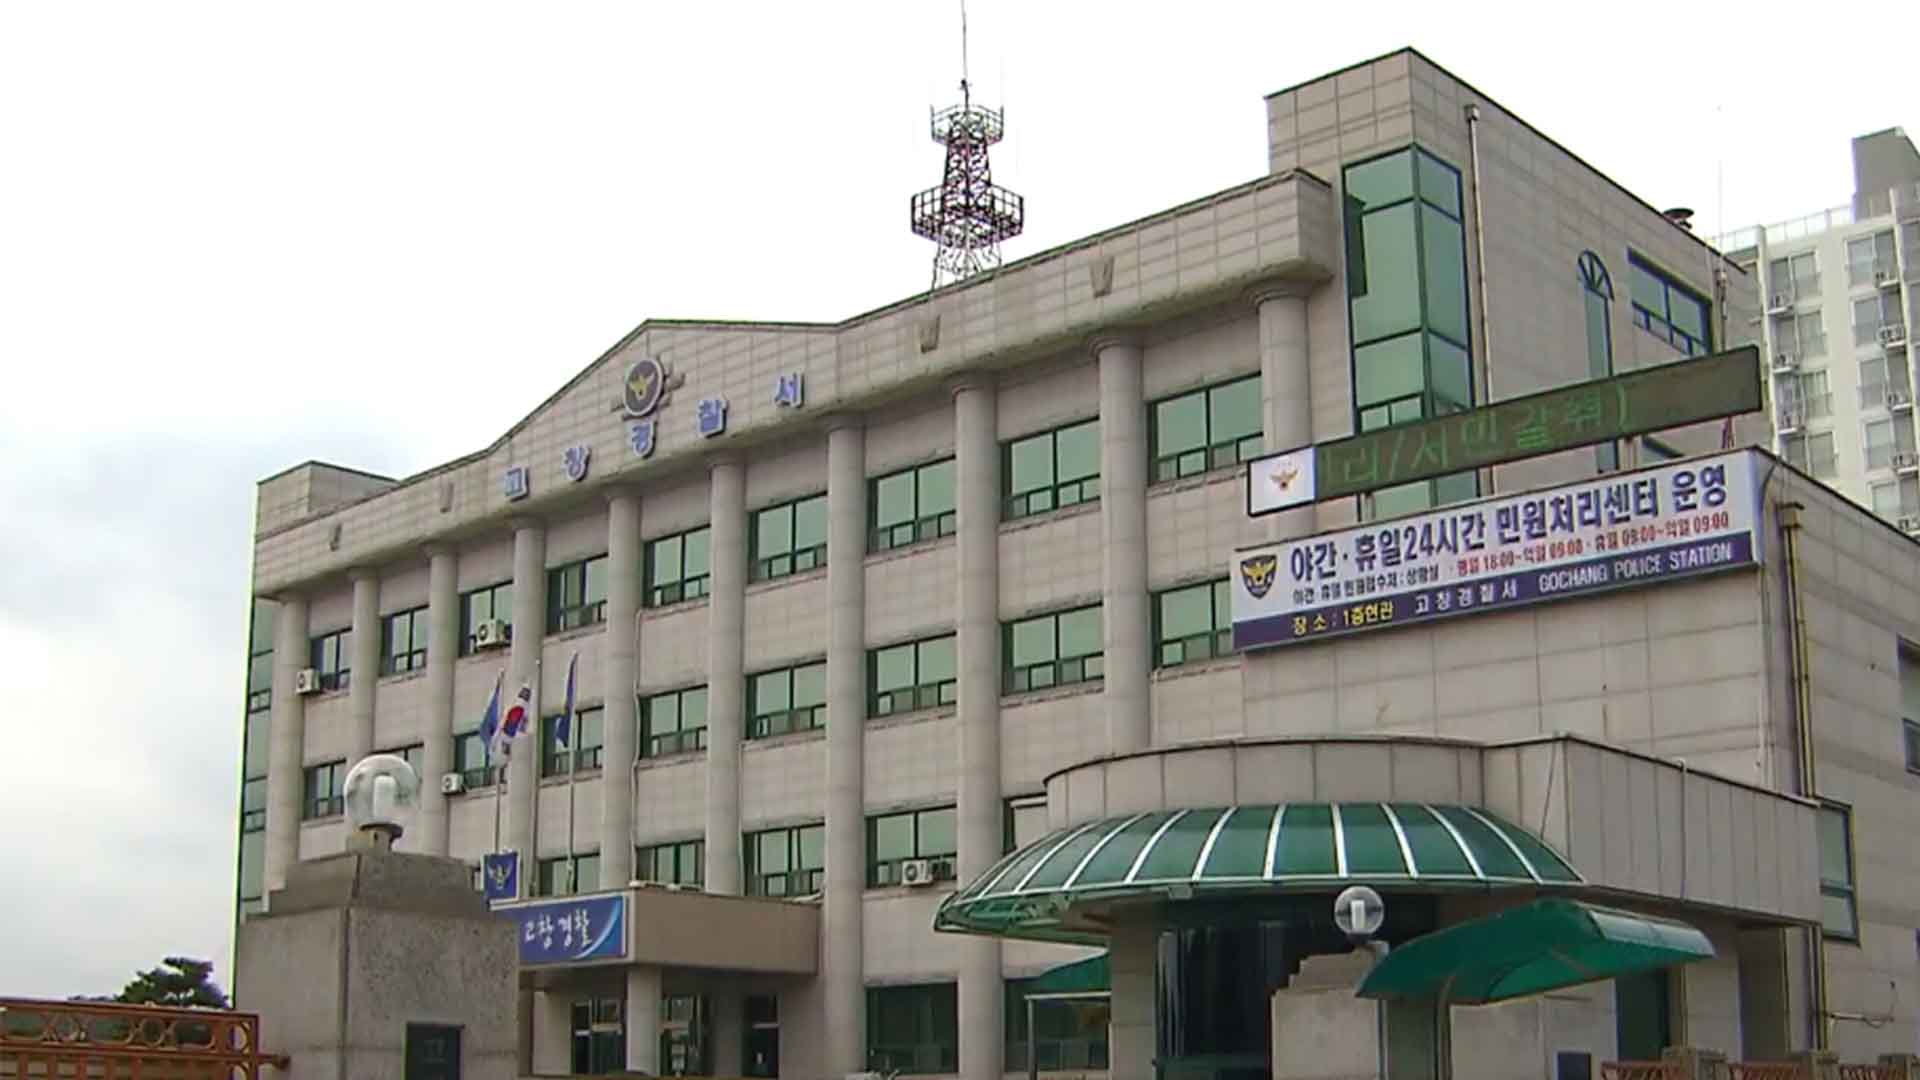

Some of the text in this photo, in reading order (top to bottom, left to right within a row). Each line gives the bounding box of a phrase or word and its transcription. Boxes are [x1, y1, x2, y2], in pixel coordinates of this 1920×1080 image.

[1496, 477, 1658, 545] 민원처리센터
[1672, 463, 1727, 512] 운영
[1694, 511, 1729, 534] 09:00
[1538, 542, 1732, 593] GOCHANG POLICE STATION
